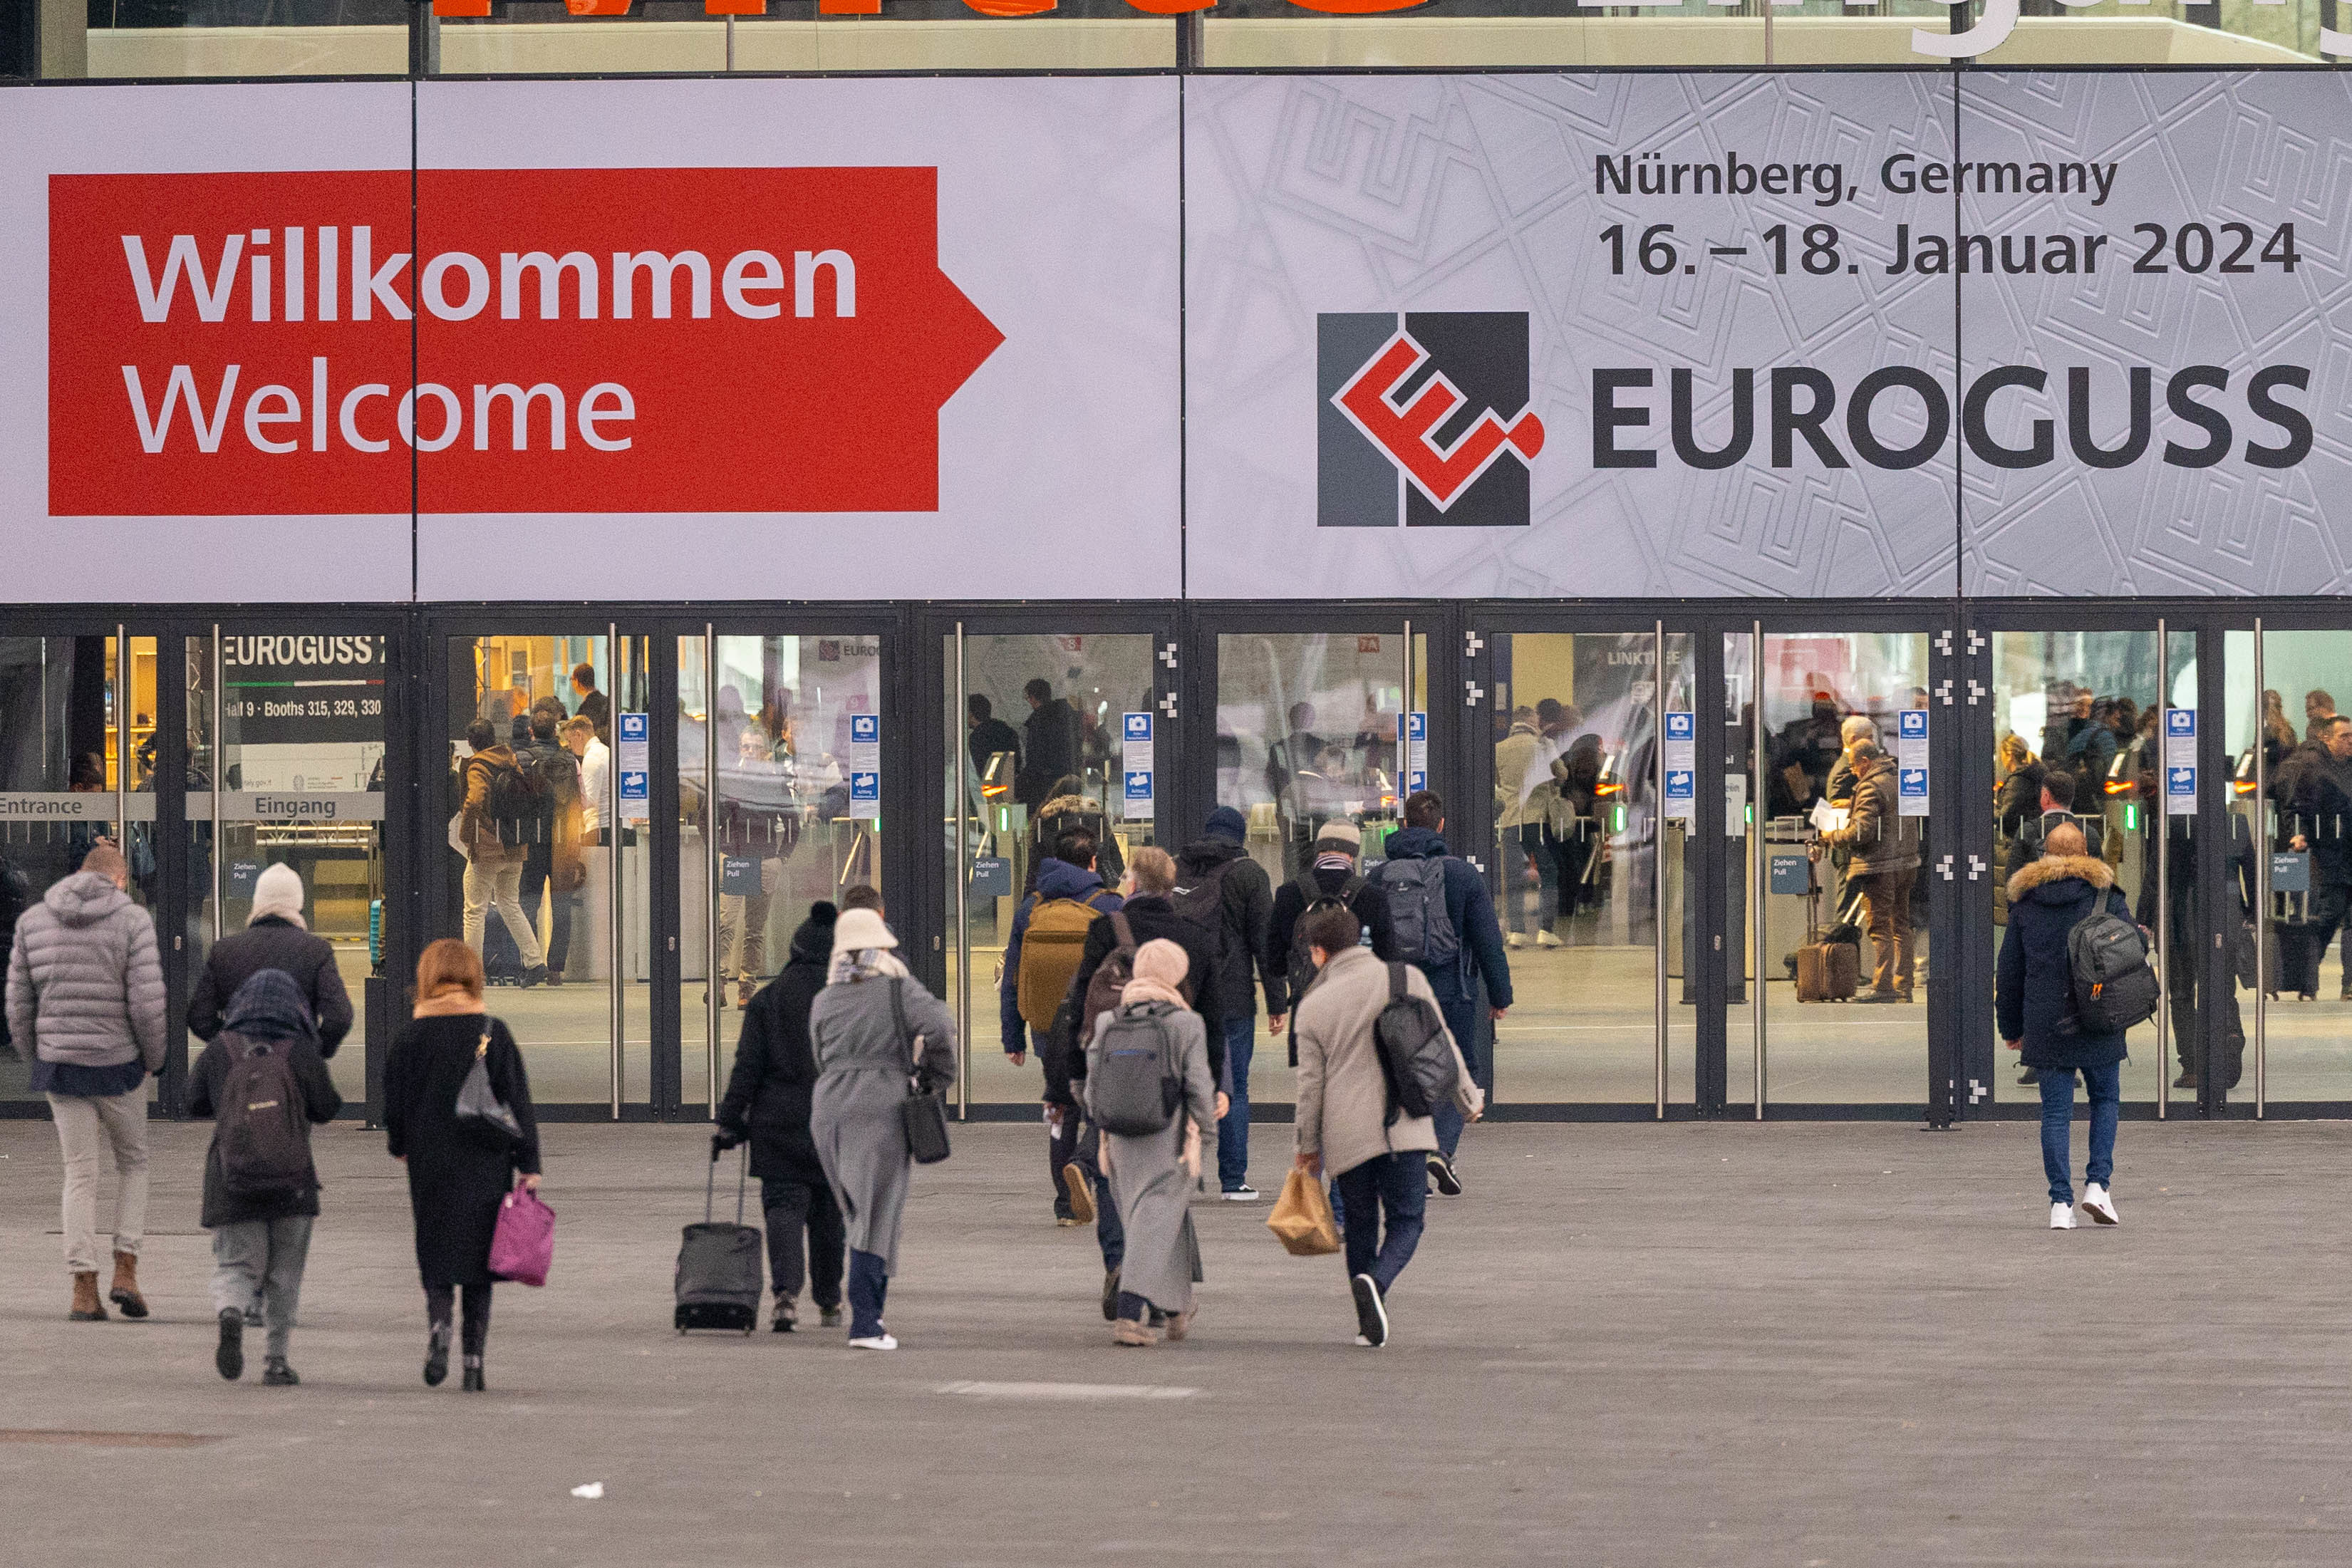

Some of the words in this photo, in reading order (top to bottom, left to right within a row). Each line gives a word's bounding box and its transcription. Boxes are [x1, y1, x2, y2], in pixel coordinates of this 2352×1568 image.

[1595, 152, 1857, 207] Nürnberg,
[1881, 152, 2118, 207] Germany
[121, 225, 856, 323] Willkommen
[1885, 223, 2108, 275] Januar
[2132, 222, 2301, 274] 2024
[121, 356, 636, 454] Welcome
[1592, 365, 2314, 470] EUROGUSS
[224, 635, 373, 665] EUROGUSS
[247, 701, 254, 717] 9
[264, 701, 304, 717] Booths
[308, 700, 331, 719] 315,
[333, 700, 358, 719] 329,
[361, 700, 381, 715] 330
[0, 797, 82, 814] Entrance
[255, 796, 336, 818] Eingang
